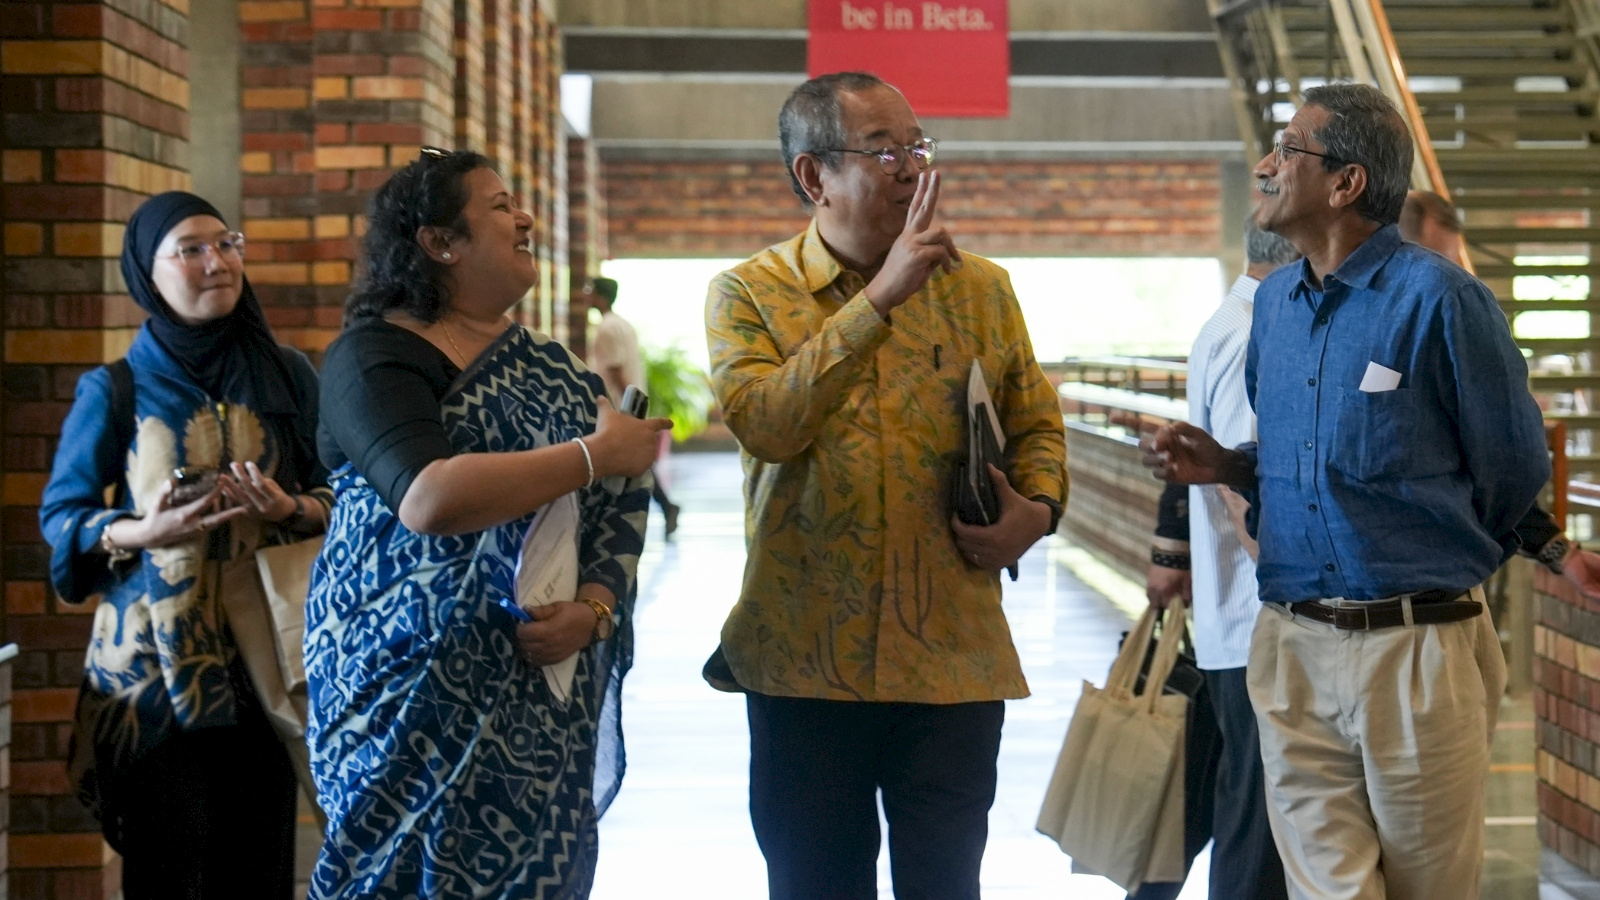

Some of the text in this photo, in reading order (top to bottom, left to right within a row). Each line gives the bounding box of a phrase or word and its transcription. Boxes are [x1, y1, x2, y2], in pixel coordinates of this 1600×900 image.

[841, 1, 994, 31] be in Beta.
